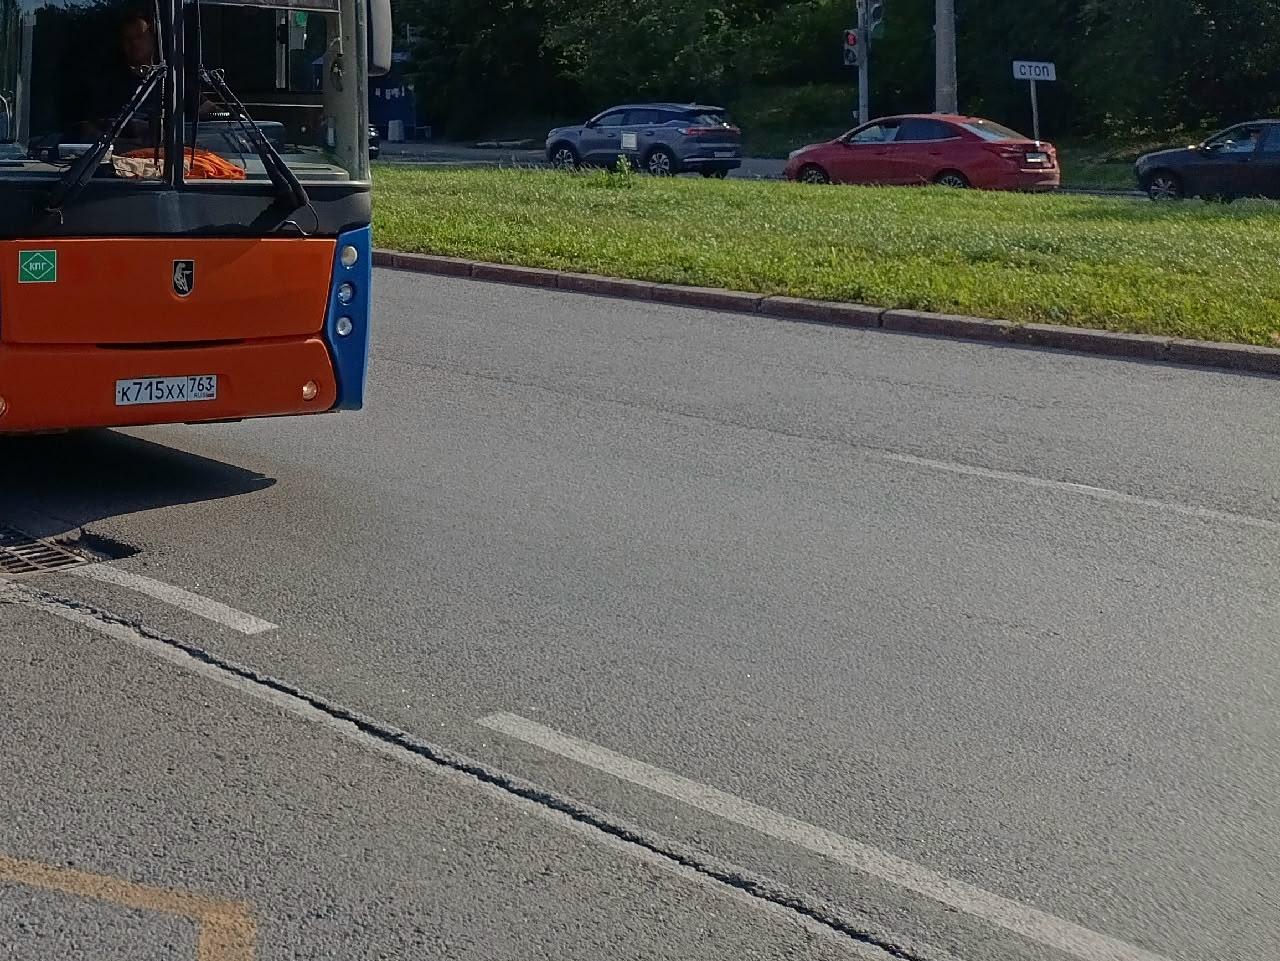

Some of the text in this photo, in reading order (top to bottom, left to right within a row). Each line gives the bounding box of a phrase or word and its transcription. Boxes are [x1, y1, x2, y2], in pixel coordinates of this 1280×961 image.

[1020, 64, 1050, 77] СТОП
[29, 262, 47, 271] КПГ
[189, 377, 213, 393] 763
